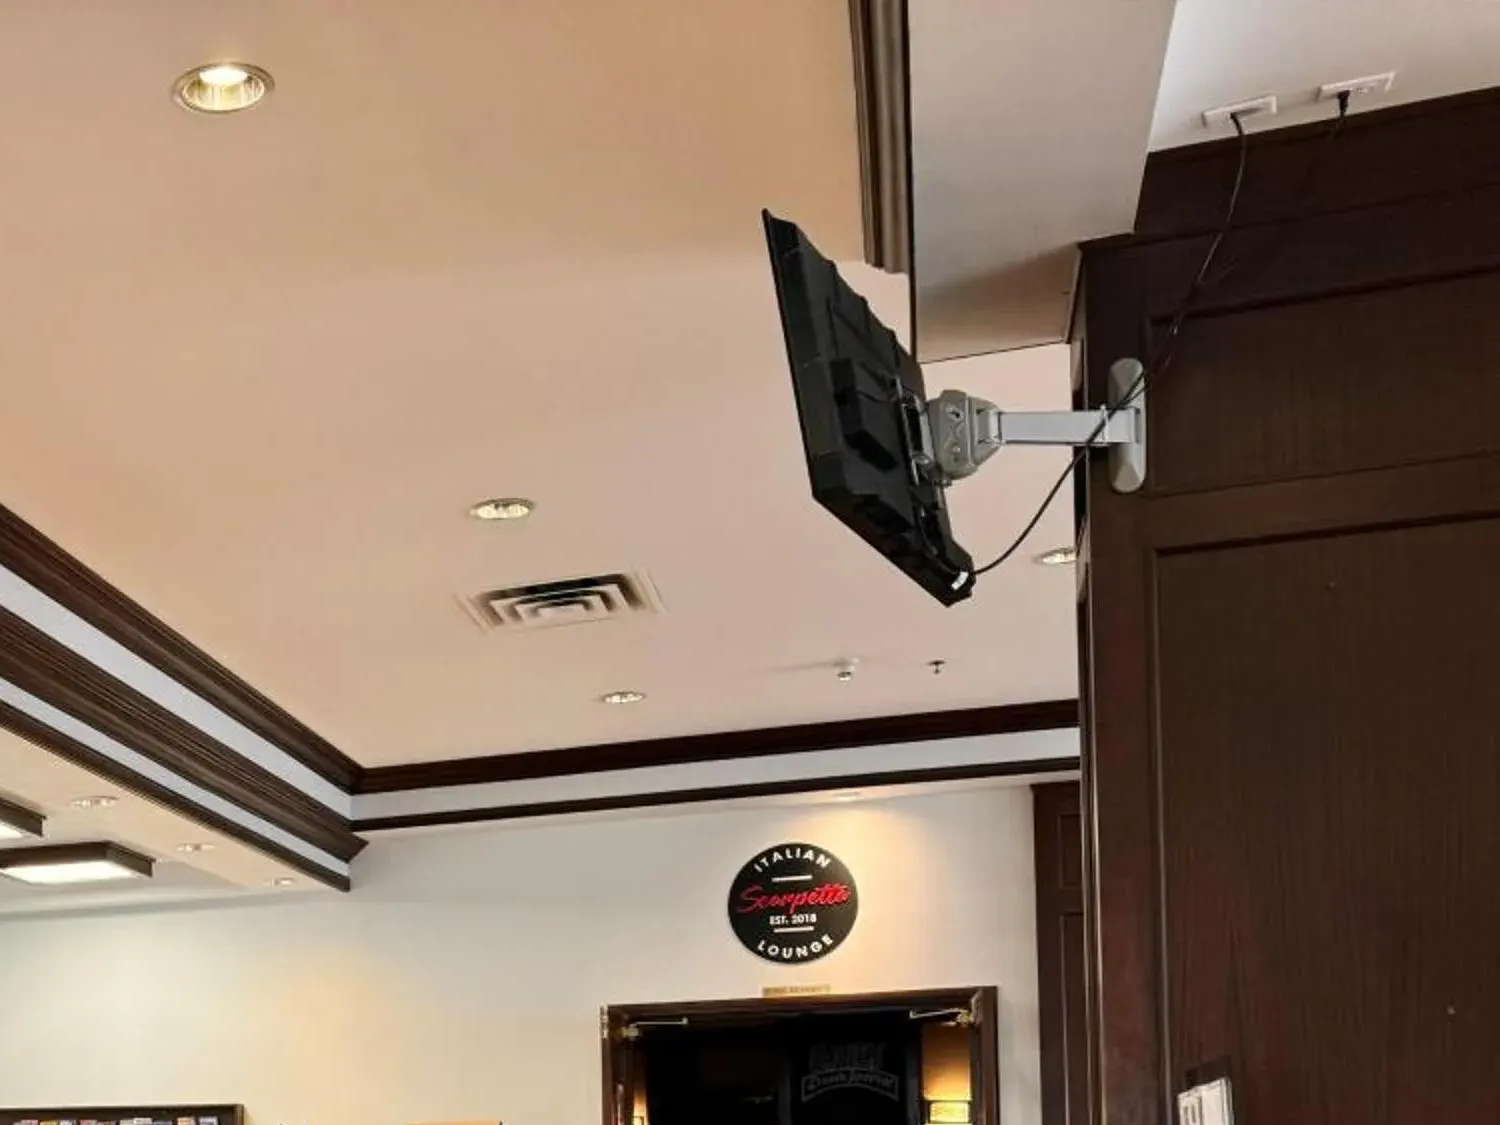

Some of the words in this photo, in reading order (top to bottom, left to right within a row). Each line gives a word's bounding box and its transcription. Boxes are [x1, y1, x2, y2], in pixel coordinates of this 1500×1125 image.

[754, 848, 830, 872] ITALIAN
[769, 915, 789, 926] EST.
[791, 913, 817, 925] 2018
[757, 933, 833, 958] LOUNGE
